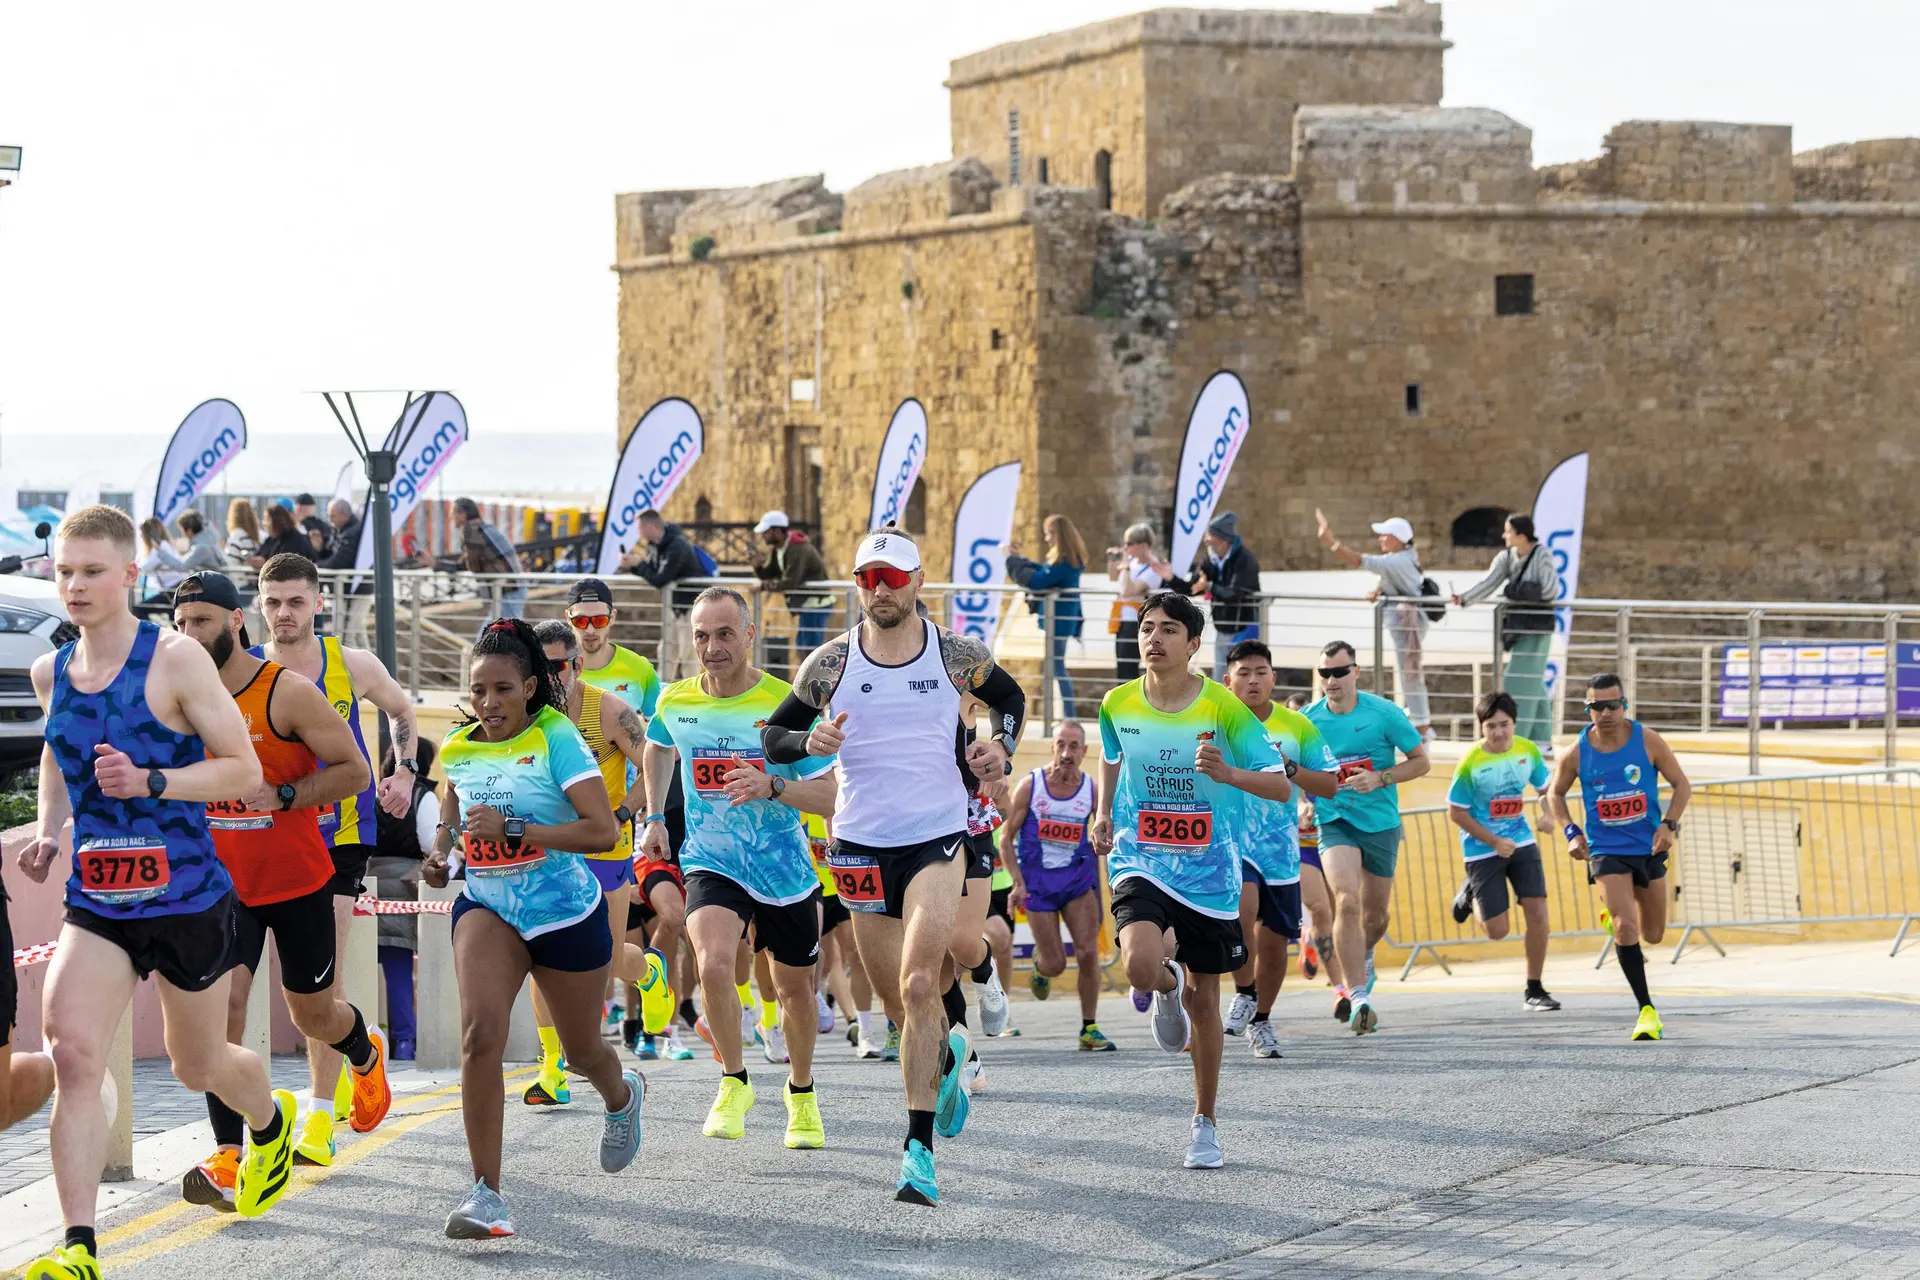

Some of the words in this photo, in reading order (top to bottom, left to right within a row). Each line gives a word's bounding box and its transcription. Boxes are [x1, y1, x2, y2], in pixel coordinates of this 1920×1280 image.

[388, 420, 458, 513] ogicom
[1179, 406, 1242, 536] Logicom
[610, 430, 694, 537] Logicom
[880, 432, 921, 529] ogicom
[908, 679, 939, 690] TRAKTOR
[678, 716, 698, 724] PAFOS
[1120, 727, 1140, 735] PAFOS
[1160, 748, 1179, 761] 27TH
[696, 763, 760, 785] 36
[1142, 763, 1194, 777] Logicom
[1145, 775, 1194, 791] CYPRUS
[470, 789, 513, 804] Logicom
[1167, 803, 1181, 811] ROAD
[1181, 803, 1196, 811] RACE
[1494, 801, 1522, 815] 377
[1601, 798, 1643, 817] 3370
[1040, 823, 1081, 840] 4005
[1143, 816, 1207, 841] 3260
[110, 838, 129, 848] ROAD
[129, 836, 147, 847] RACE
[832, 857, 846, 866] ROAD
[846, 857, 862, 866] RACE
[88, 855, 160, 885] 3778
[832, 871, 877, 896] 294
